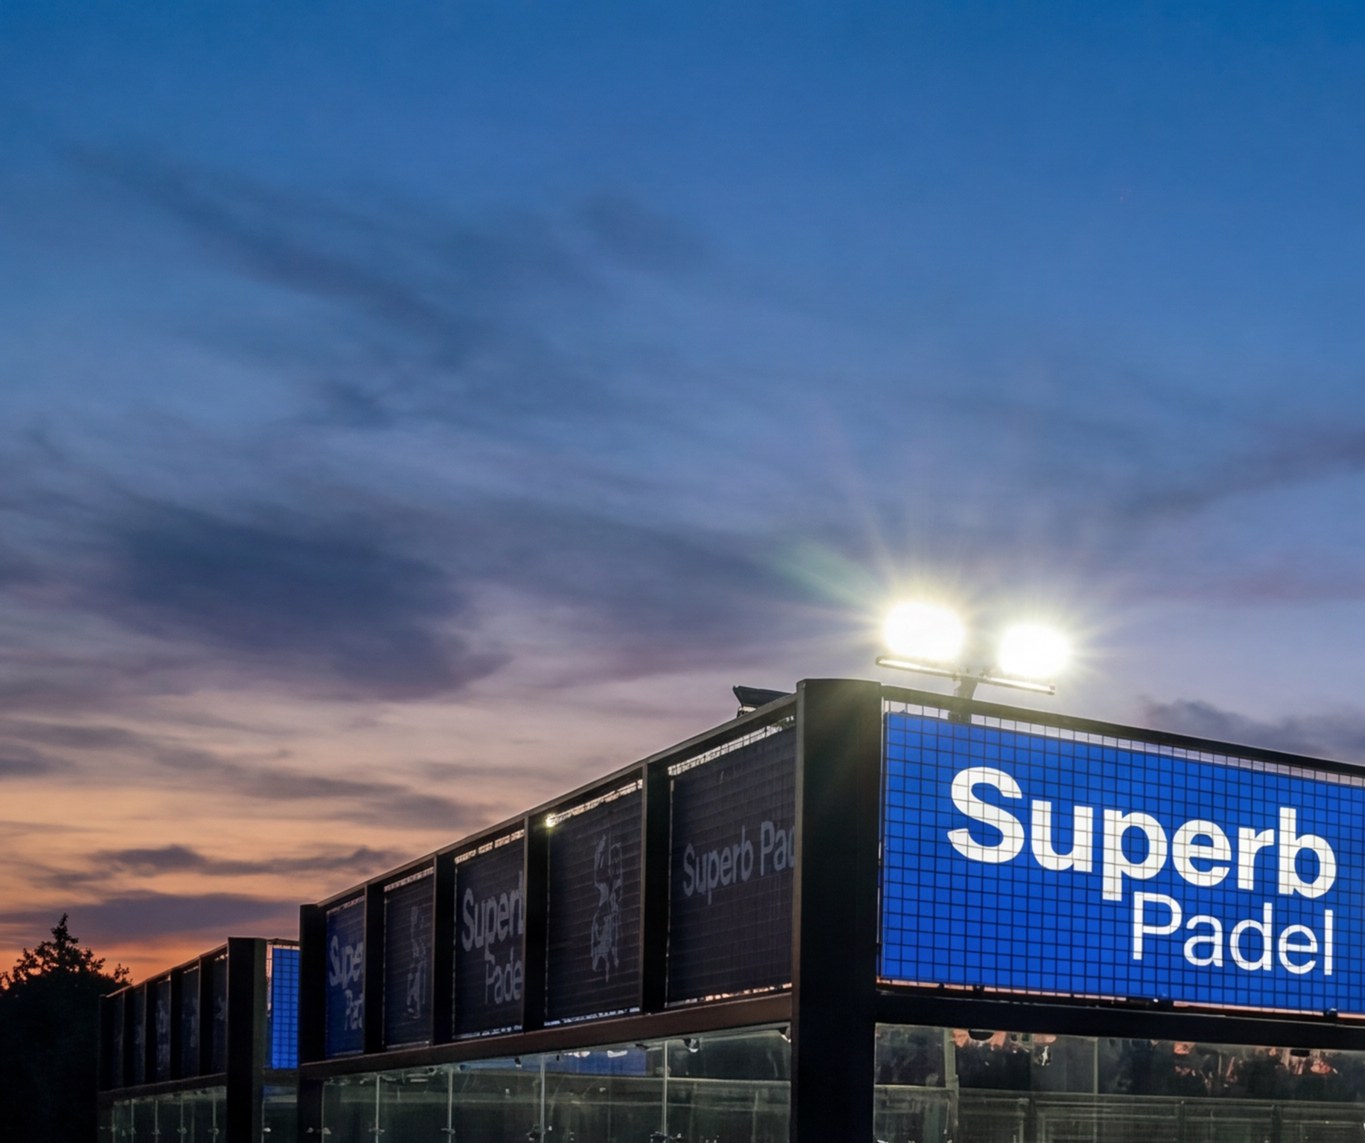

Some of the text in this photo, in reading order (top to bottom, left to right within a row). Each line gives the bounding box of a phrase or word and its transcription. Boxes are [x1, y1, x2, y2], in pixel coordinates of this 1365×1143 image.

[682, 832, 753, 904] Superb
[947, 767, 1337, 901] Superb
[1132, 891, 1334, 976] Padel
